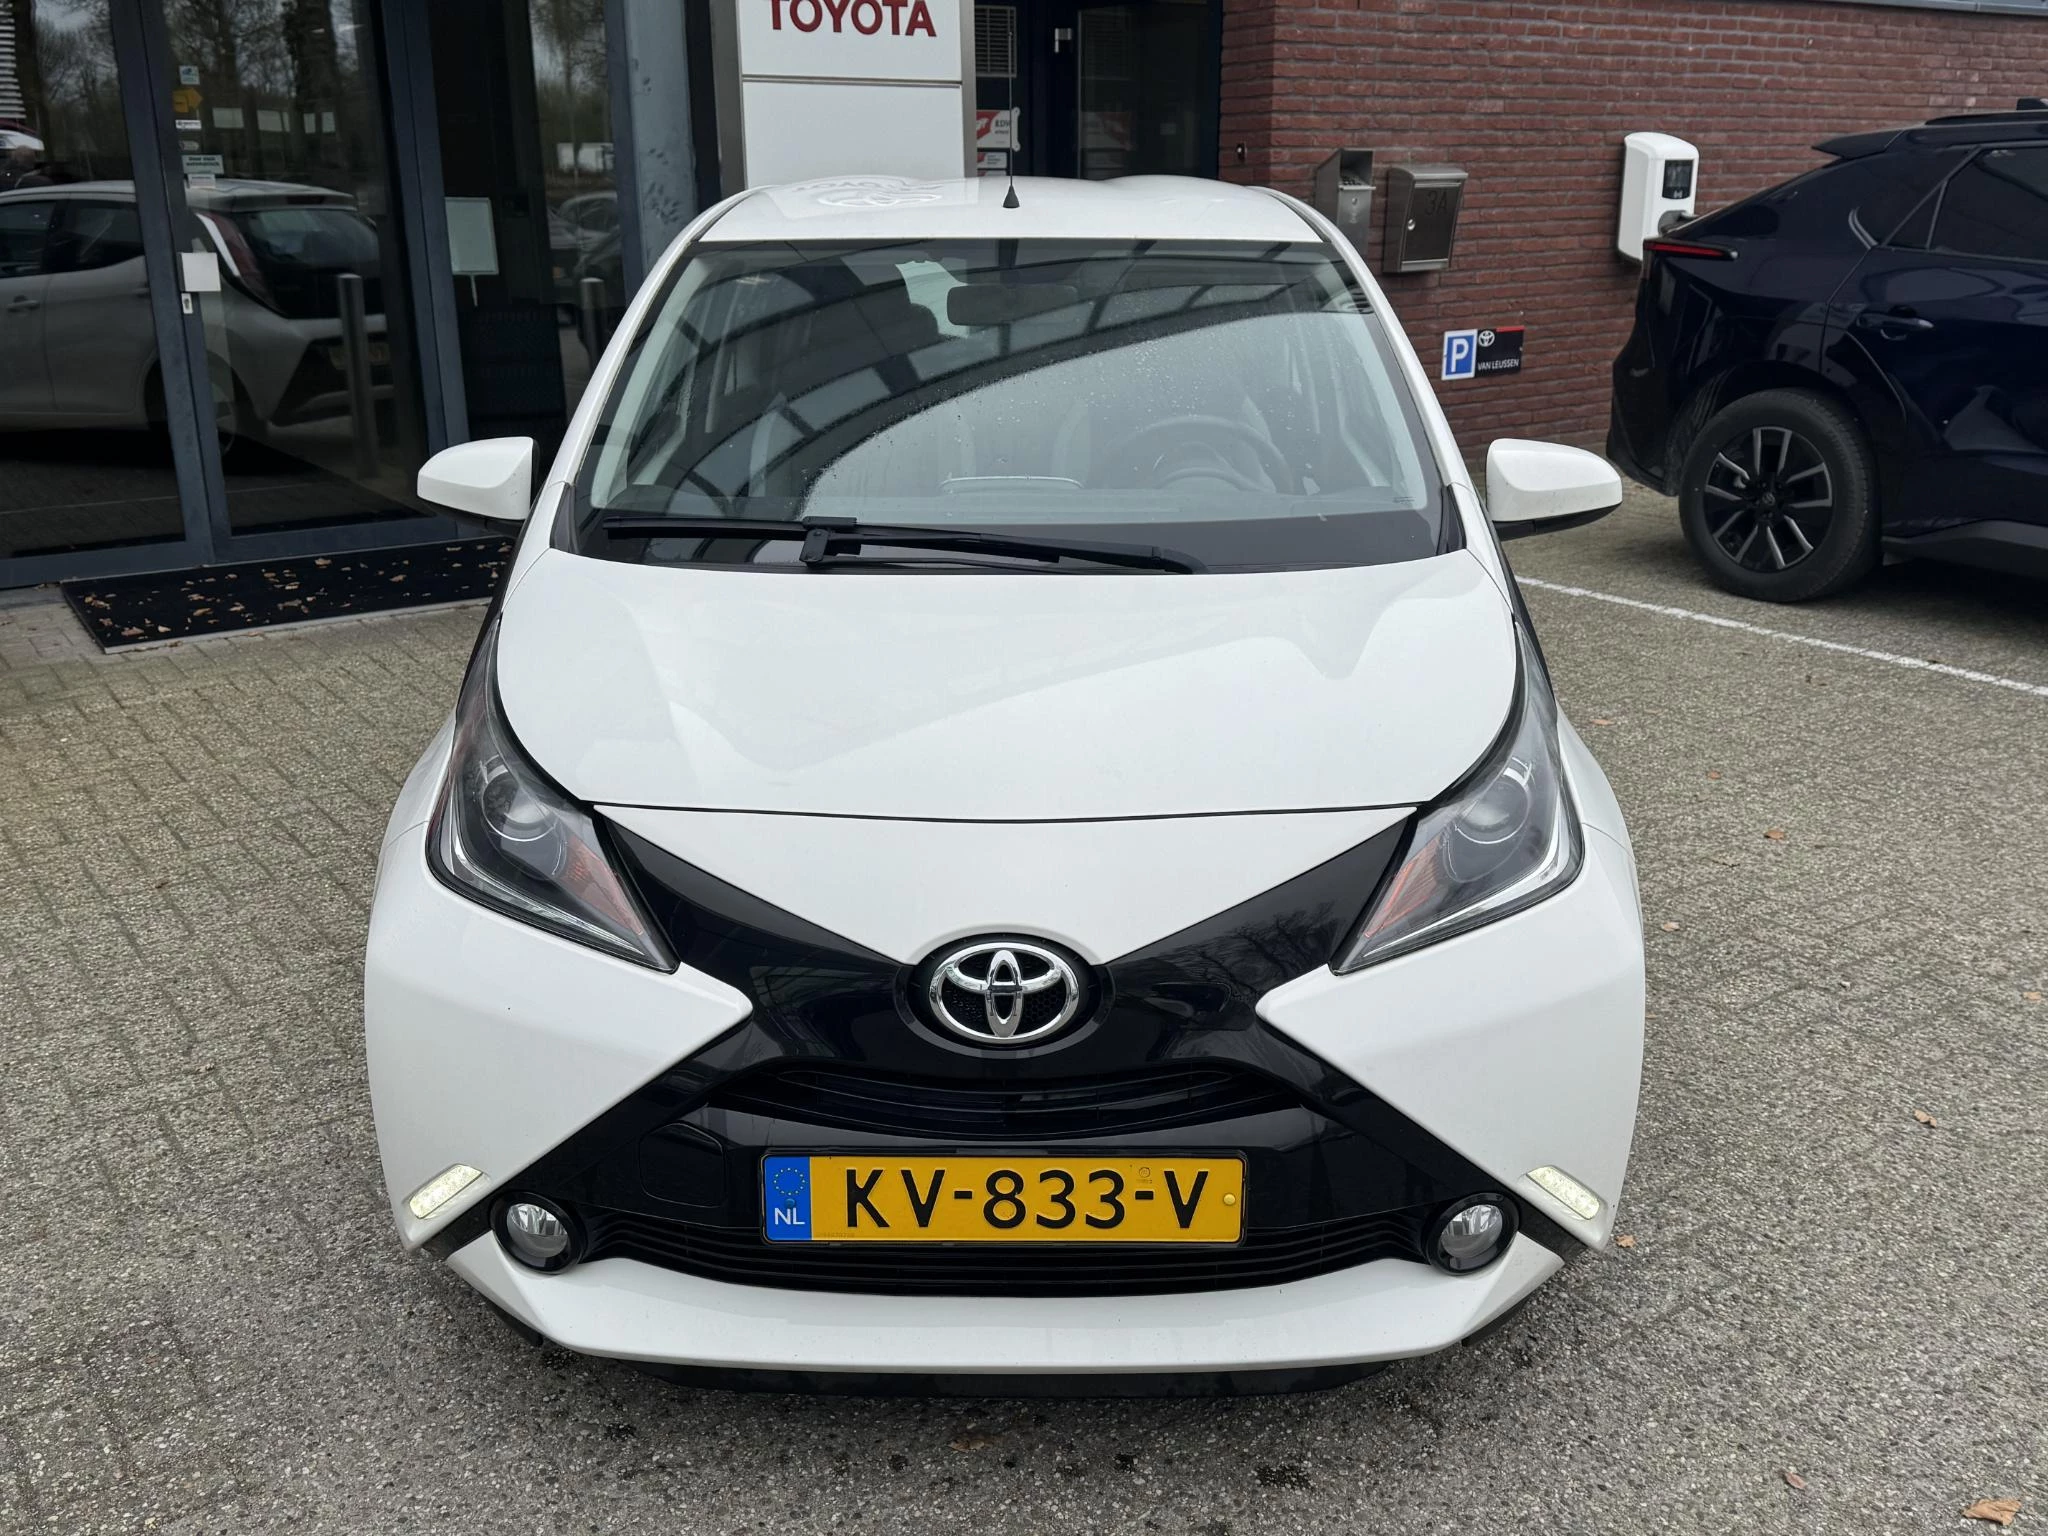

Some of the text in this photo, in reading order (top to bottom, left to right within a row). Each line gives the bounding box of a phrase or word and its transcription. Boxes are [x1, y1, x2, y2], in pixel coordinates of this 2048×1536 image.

[769, 0, 937, 37] TOYOTA
[1450, 338, 1470, 373] P
[1477, 358, 1520, 371] VAN LEUSSEN
[774, 1207, 805, 1226] NL
[845, 1168, 1209, 1230] KV-833-V
